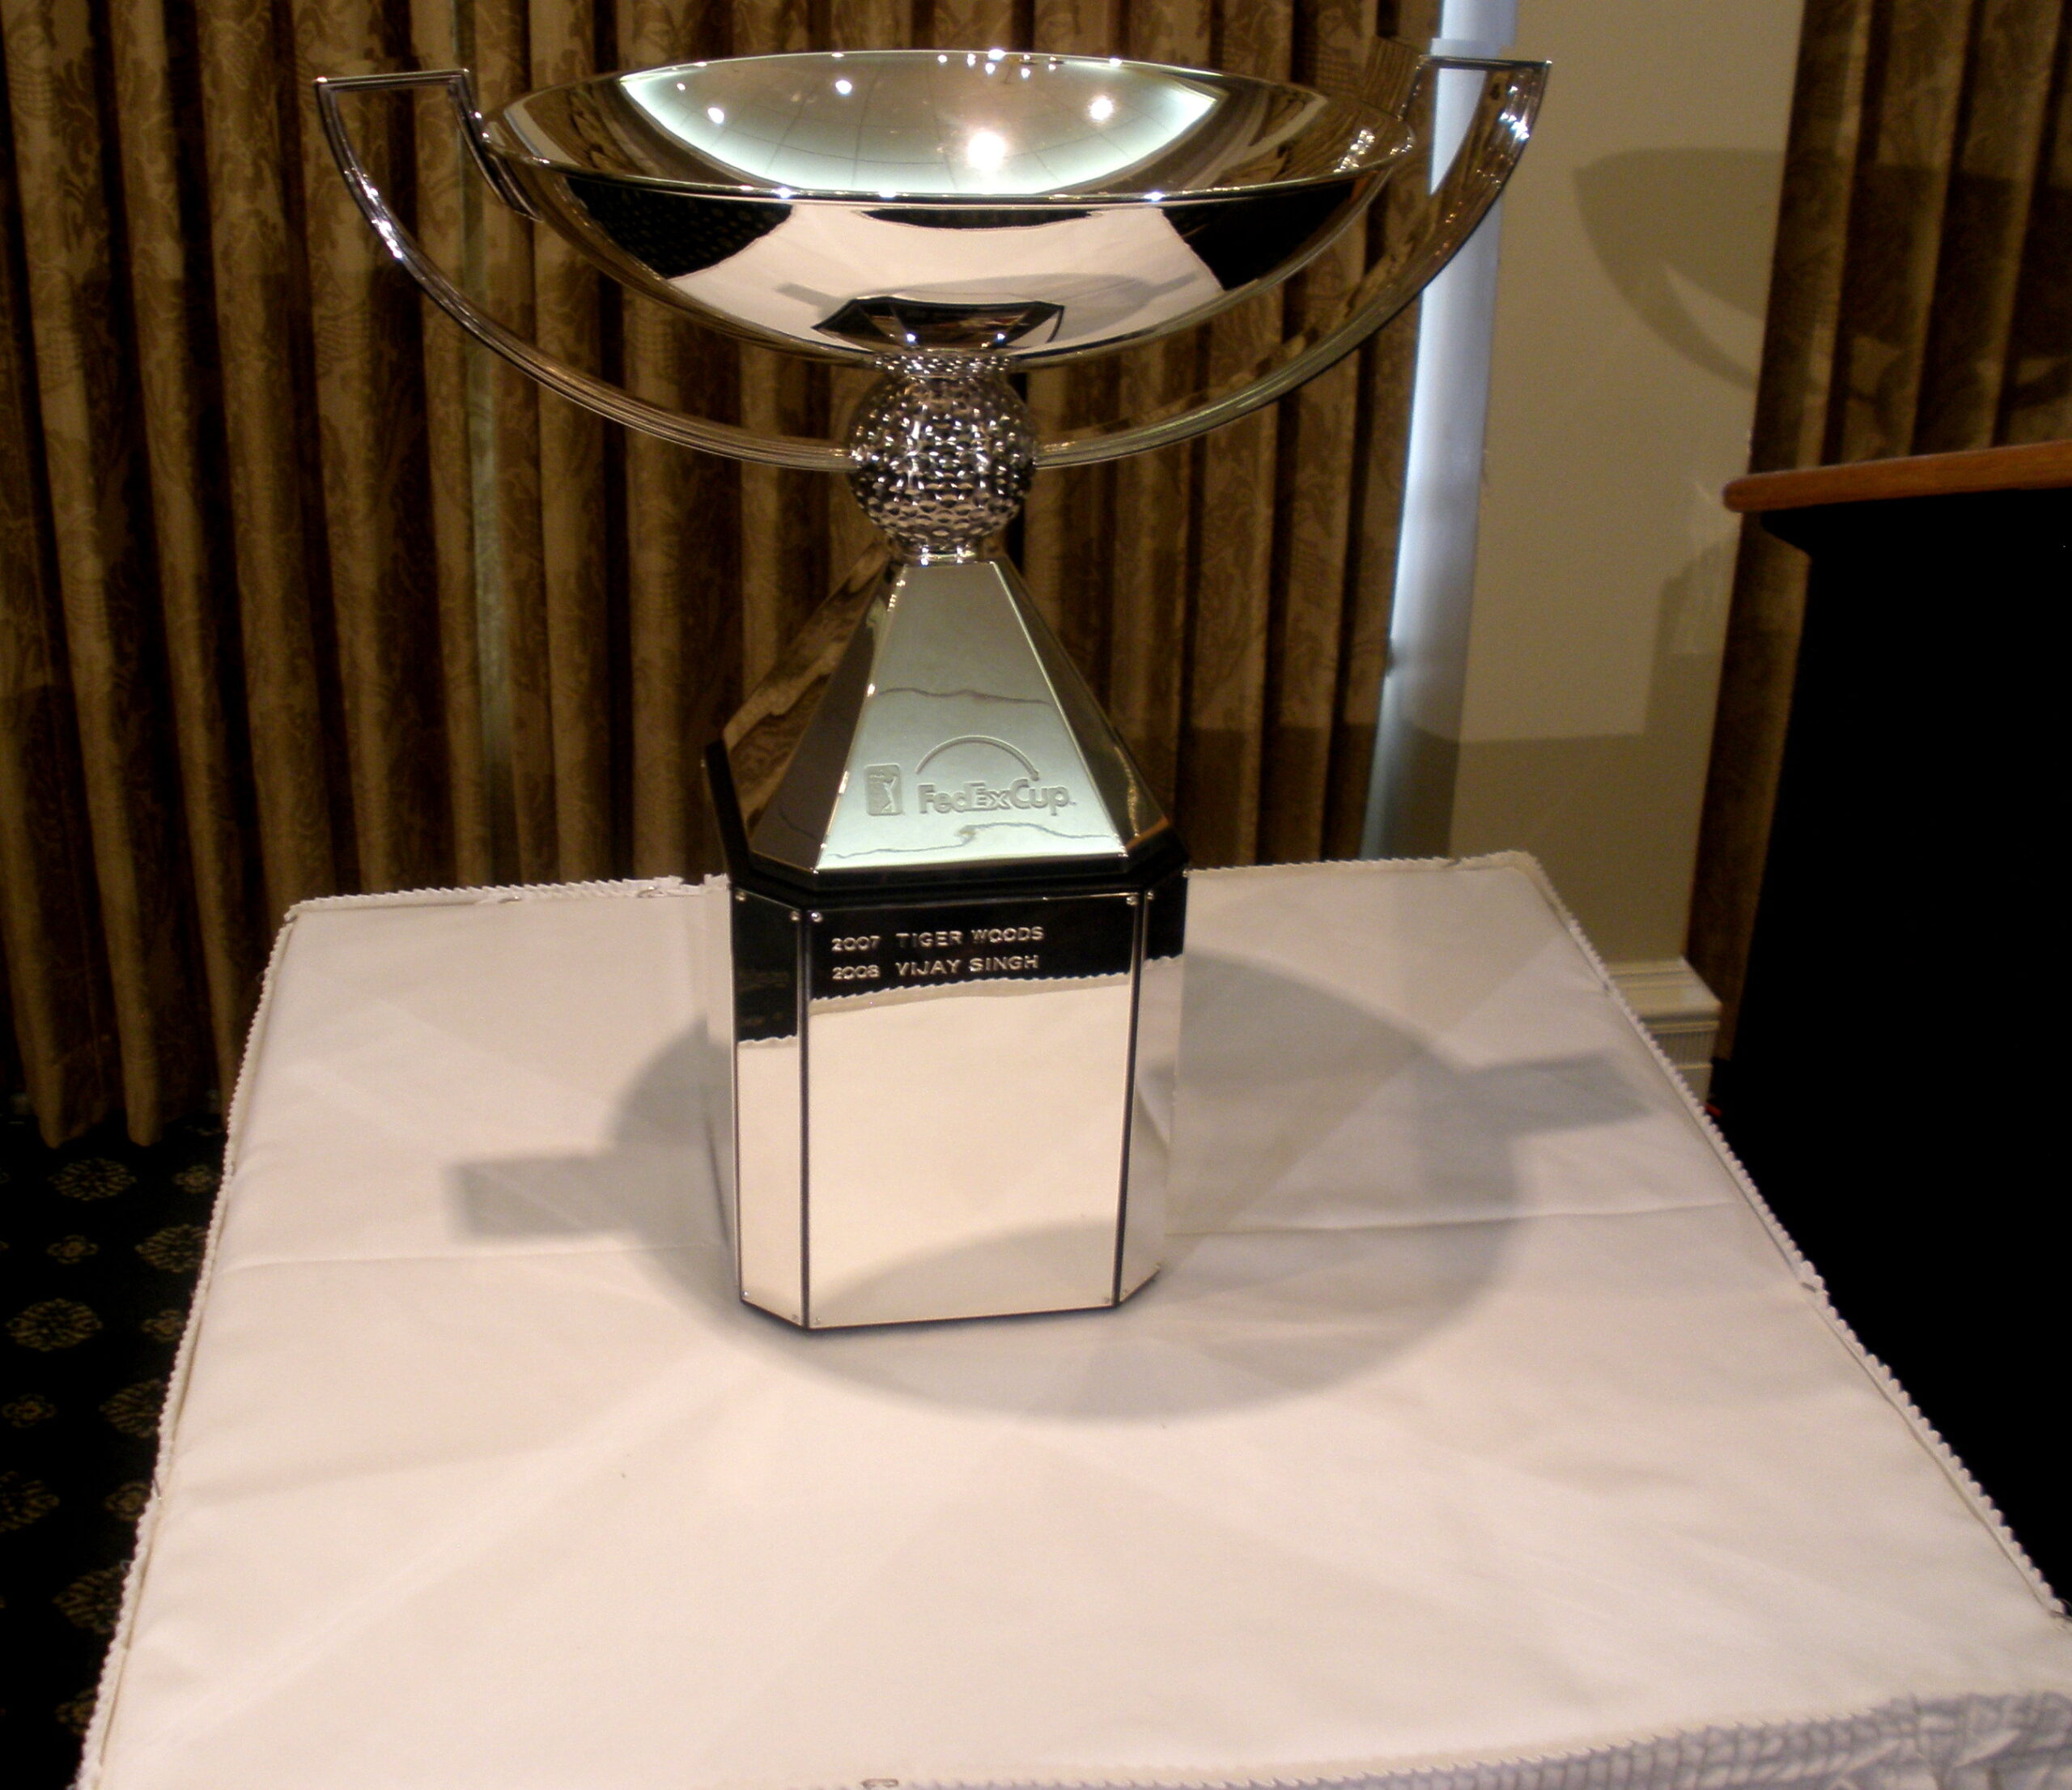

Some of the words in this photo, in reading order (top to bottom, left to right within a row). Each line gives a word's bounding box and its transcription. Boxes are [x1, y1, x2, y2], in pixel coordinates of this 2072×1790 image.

[917, 778, 1071, 816] FedExCup
[831, 935, 881, 952] 2007
[895, 929, 964, 947] TIGER
[970, 926, 1046, 944] WOODS
[831, 963, 881, 980] 2008
[895, 959, 962, 976] VIJAY
[970, 955, 1040, 972] SINGH
